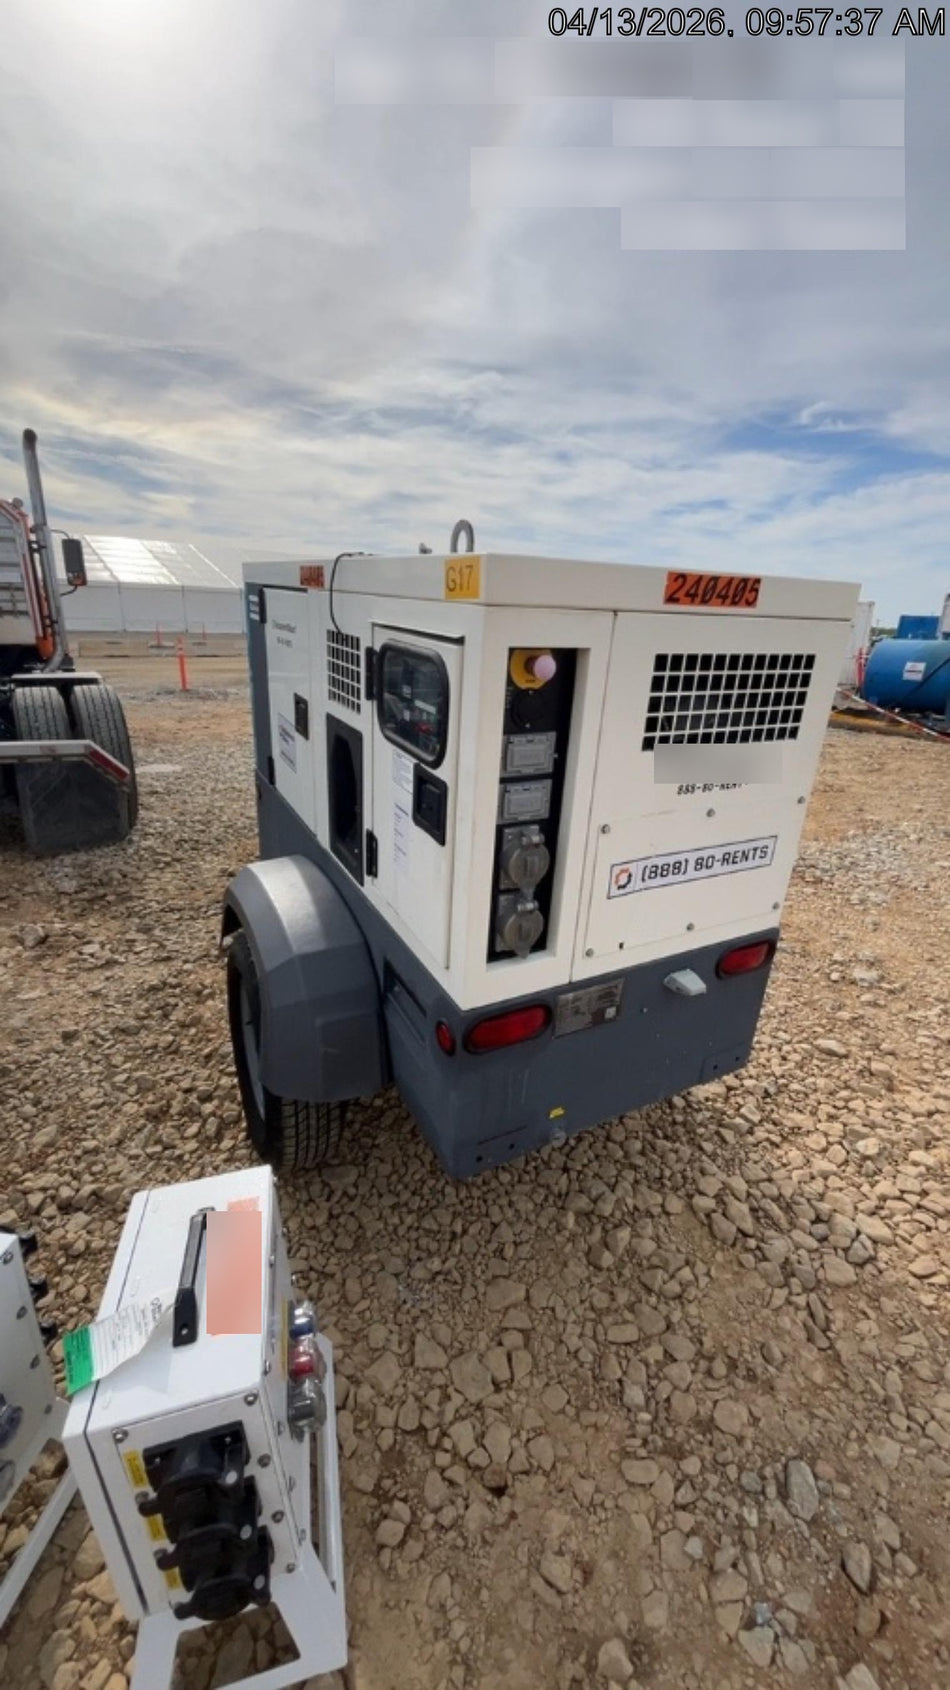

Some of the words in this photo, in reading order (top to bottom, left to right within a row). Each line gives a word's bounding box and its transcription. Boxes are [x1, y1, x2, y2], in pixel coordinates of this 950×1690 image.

[445, 564, 474, 593] G17
[665, 573, 760, 606] 240405
[641, 858, 690, 883] (888)
[694, 844, 769, 871] 80-RENTS
